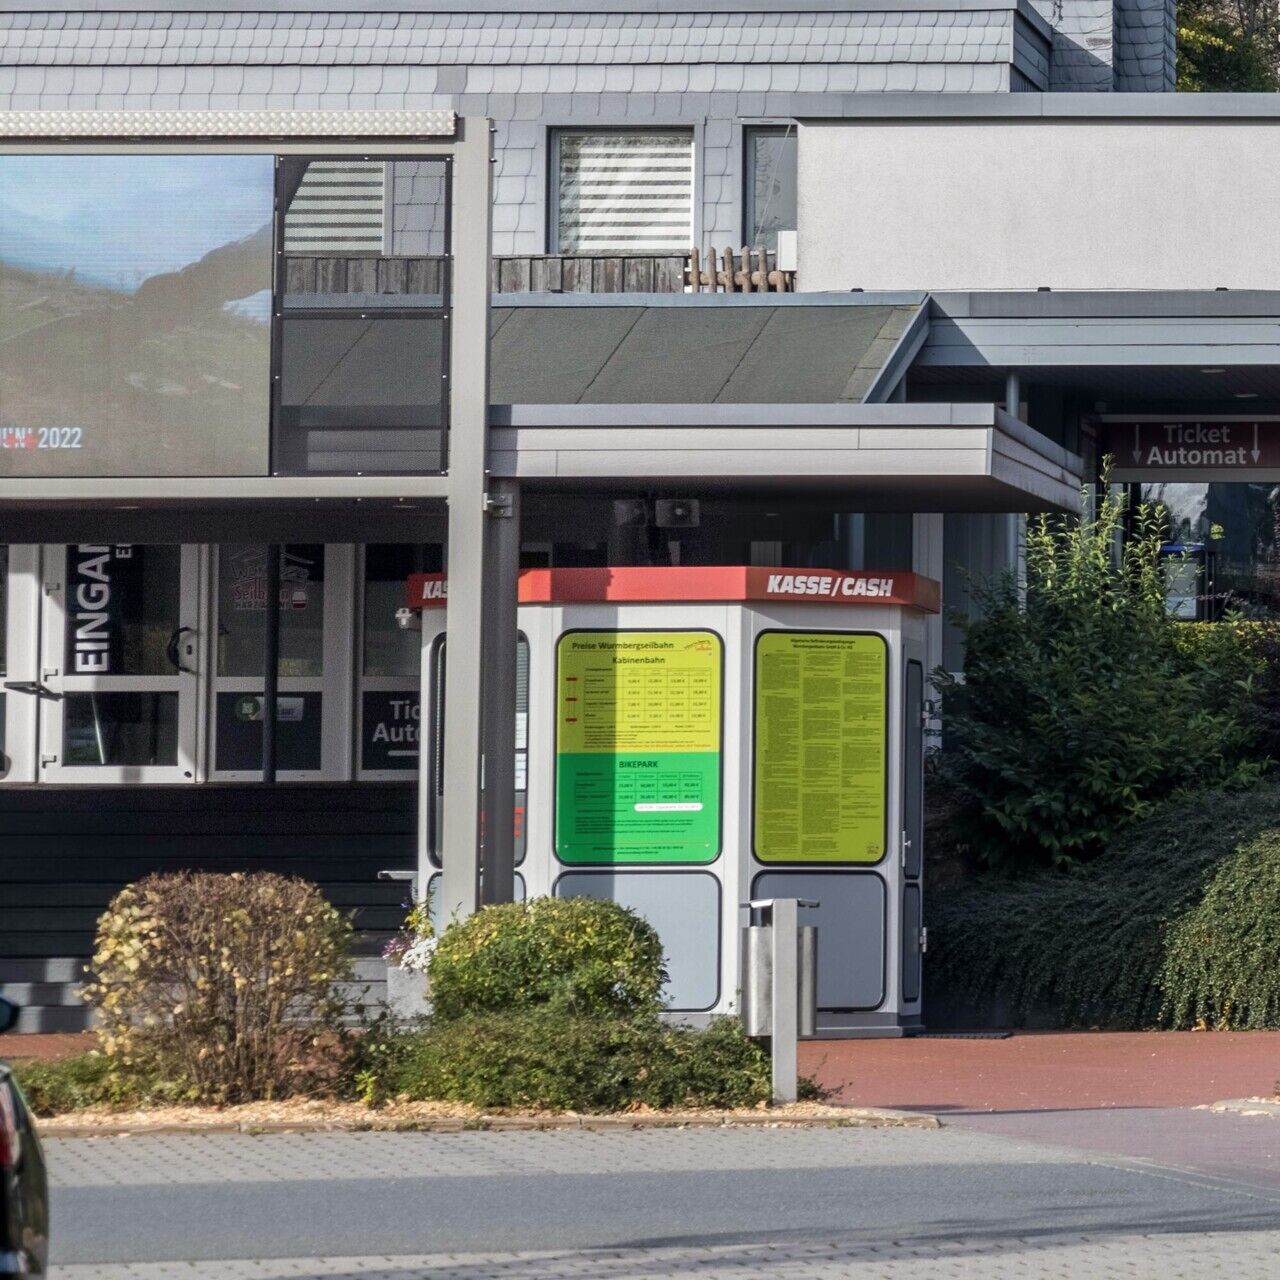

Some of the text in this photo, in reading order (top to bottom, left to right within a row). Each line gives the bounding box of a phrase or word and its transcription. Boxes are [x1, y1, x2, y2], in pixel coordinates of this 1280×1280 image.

[38, 427, 82, 448] 2022
[1163, 424, 1230, 443] Ticket
[1146, 446, 1247, 465] Automat
[767, 574, 894, 597] KASSE/CASH
[572, 642, 596, 650] Preise
[599, 641, 674, 651] Wurmbergseilbahn
[612, 656, 666, 664] Kabinenbahn
[619, 760, 658, 768] BIKEPARK
